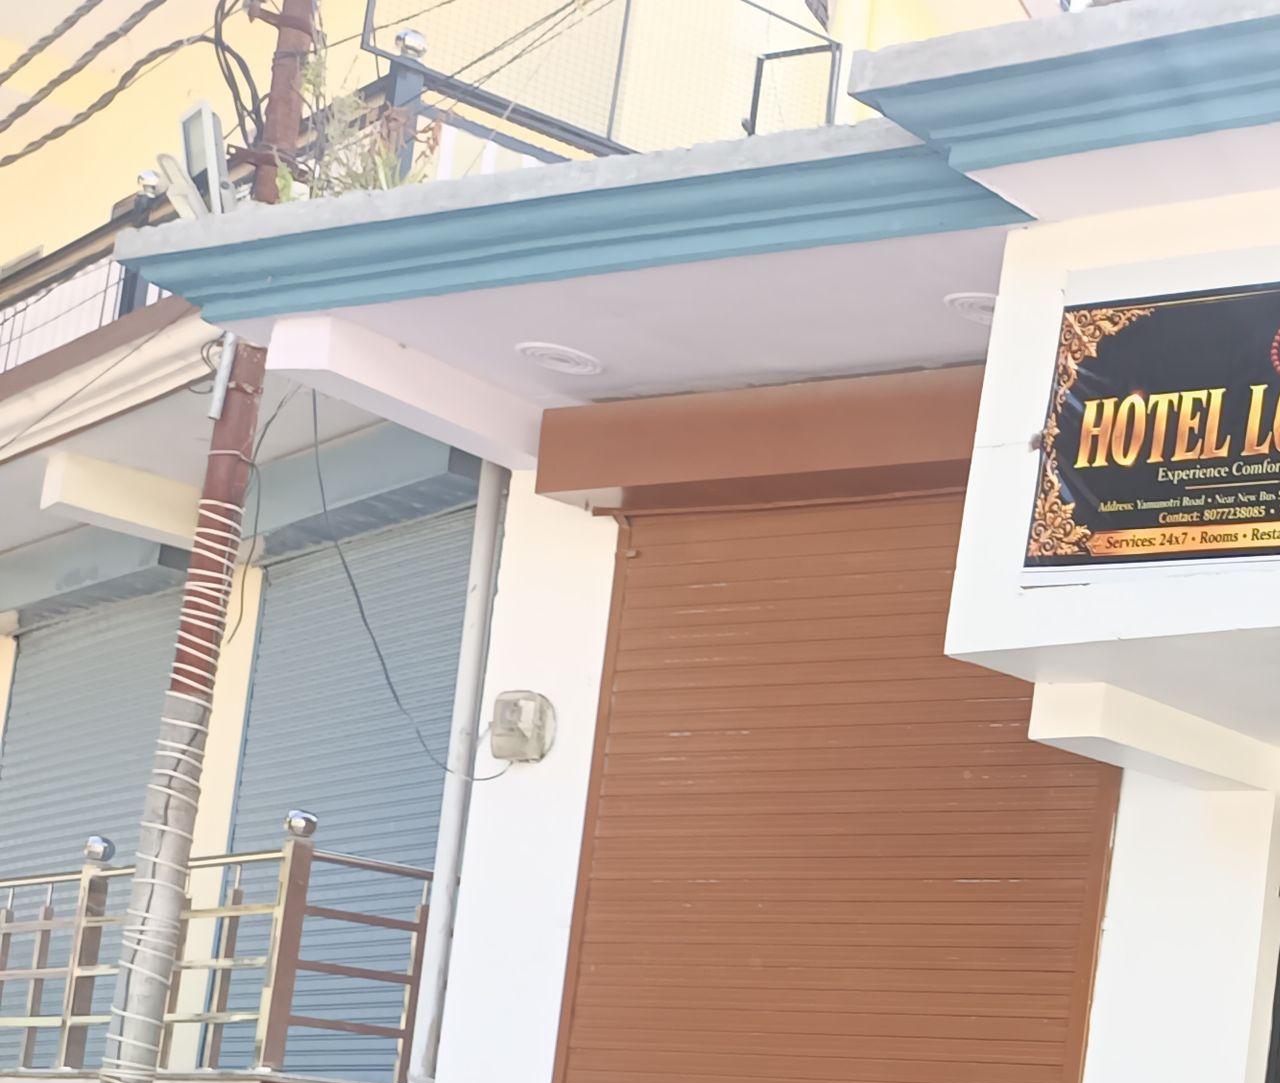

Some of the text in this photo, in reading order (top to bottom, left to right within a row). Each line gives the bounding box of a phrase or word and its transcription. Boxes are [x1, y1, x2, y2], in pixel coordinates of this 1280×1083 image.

[1073, 388, 1231, 468] HOTEL
[1158, 464, 1229, 484] Experience
[1182, 495, 1205, 506] Road
[1215, 493, 1235, 504] Near
[1238, 492, 1257, 502] New
[1260, 490, 1276, 501] Bus
[1159, 511, 1200, 523] Contact:
[1203, 506, 1266, 521] 8077238085
[1105, 534, 1156, 549] Services:
[1160, 532, 1188, 546] 24x7
[1200, 531, 1238, 544] Rooms
